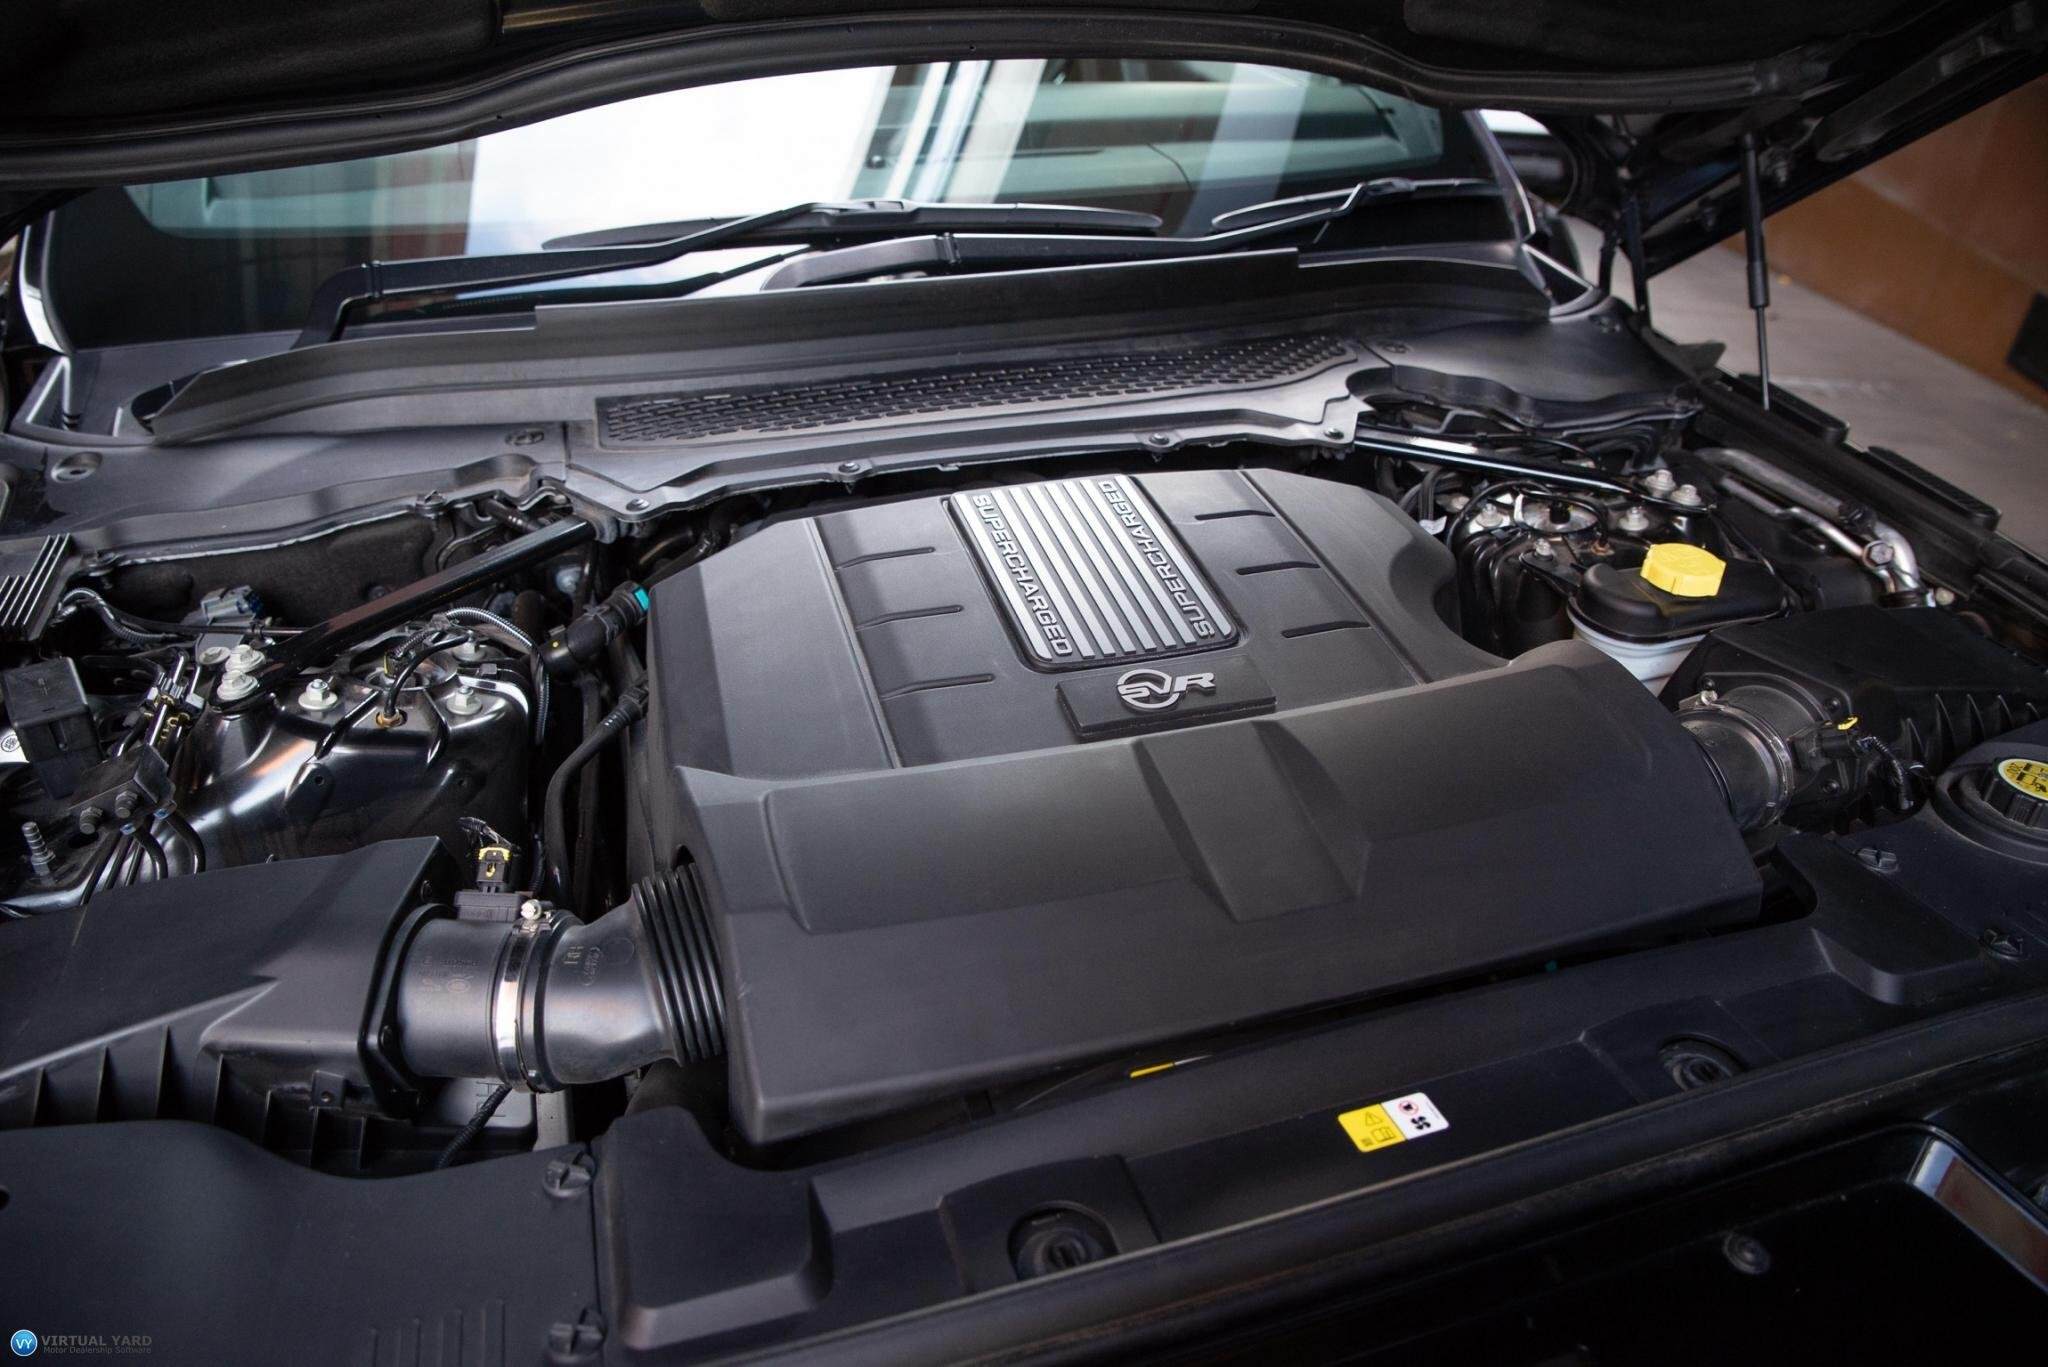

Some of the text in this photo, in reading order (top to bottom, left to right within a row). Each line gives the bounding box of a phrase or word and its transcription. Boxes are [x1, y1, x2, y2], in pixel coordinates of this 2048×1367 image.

[972, 493, 1073, 657] SUPERCHARGED
[1098, 479, 1215, 639] SUPERCHARGED
[1117, 668, 1216, 709] SVR
